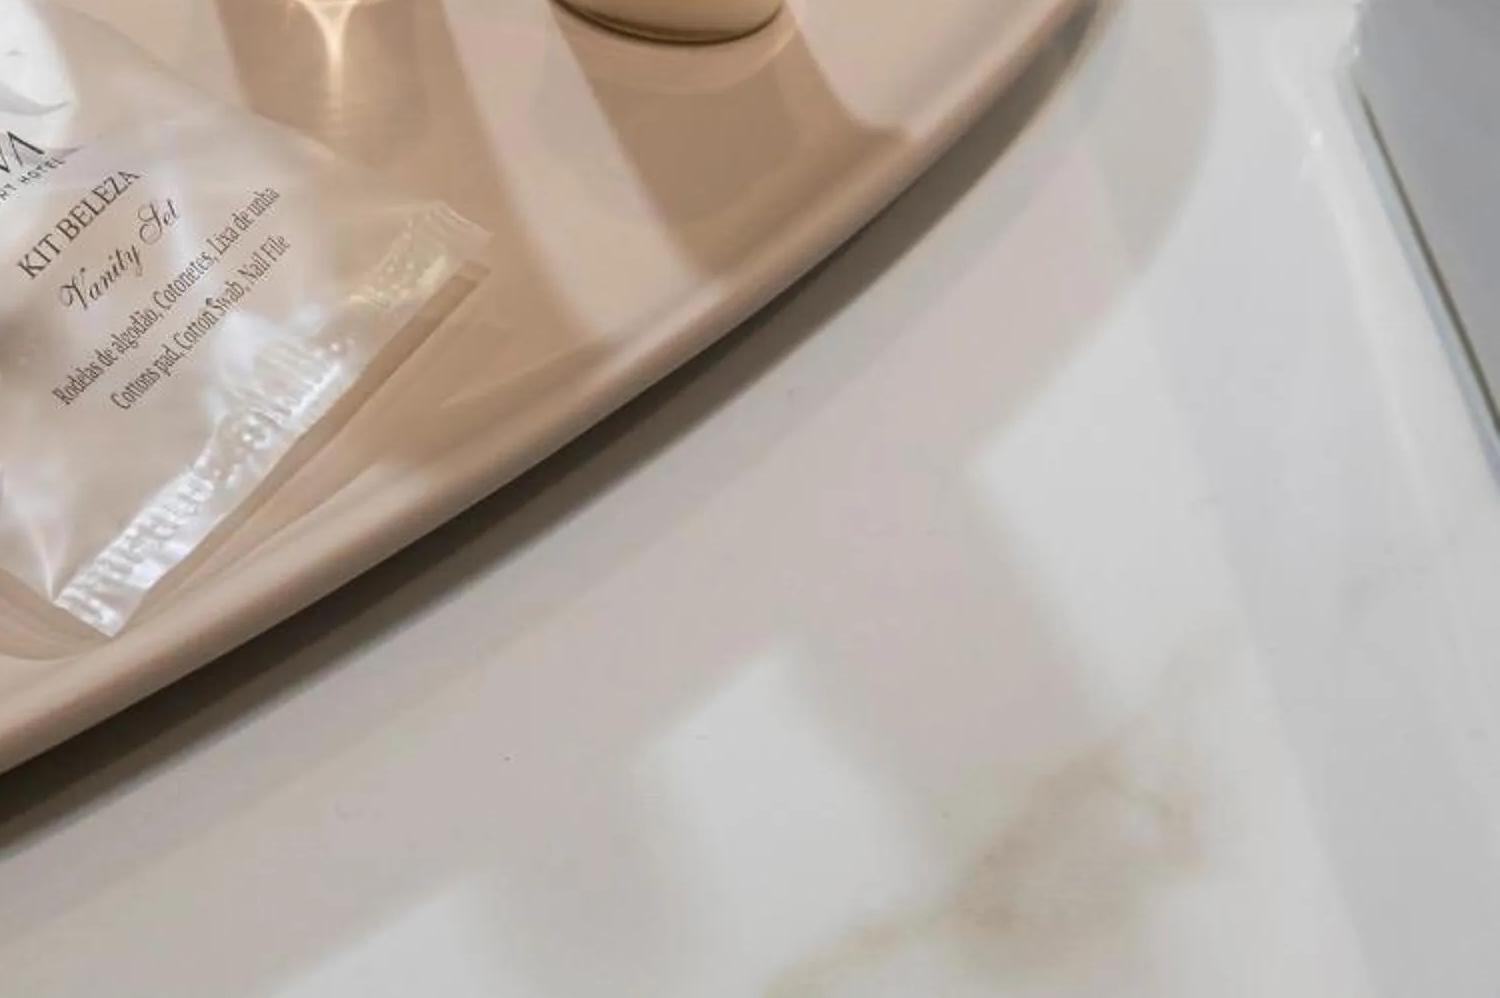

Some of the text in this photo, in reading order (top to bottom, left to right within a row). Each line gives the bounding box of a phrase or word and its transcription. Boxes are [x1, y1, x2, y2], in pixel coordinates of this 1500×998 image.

[15, 168, 143, 282] KIT BELEZA
[20, 155, 67, 185] HOTEL
[52, 361, 106, 406] Rodelas
[94, 348, 119, 368] de
[205, 226, 241, 256] Lixa
[231, 212, 257, 232] de
[247, 186, 281, 218] unha
[58, 197, 183, 311] Vanity Set
[110, 367, 162, 410] Cottons
[173, 307, 221, 351] Cotton
[237, 251, 271, 286] Nail
[260, 235, 291, 263] File
